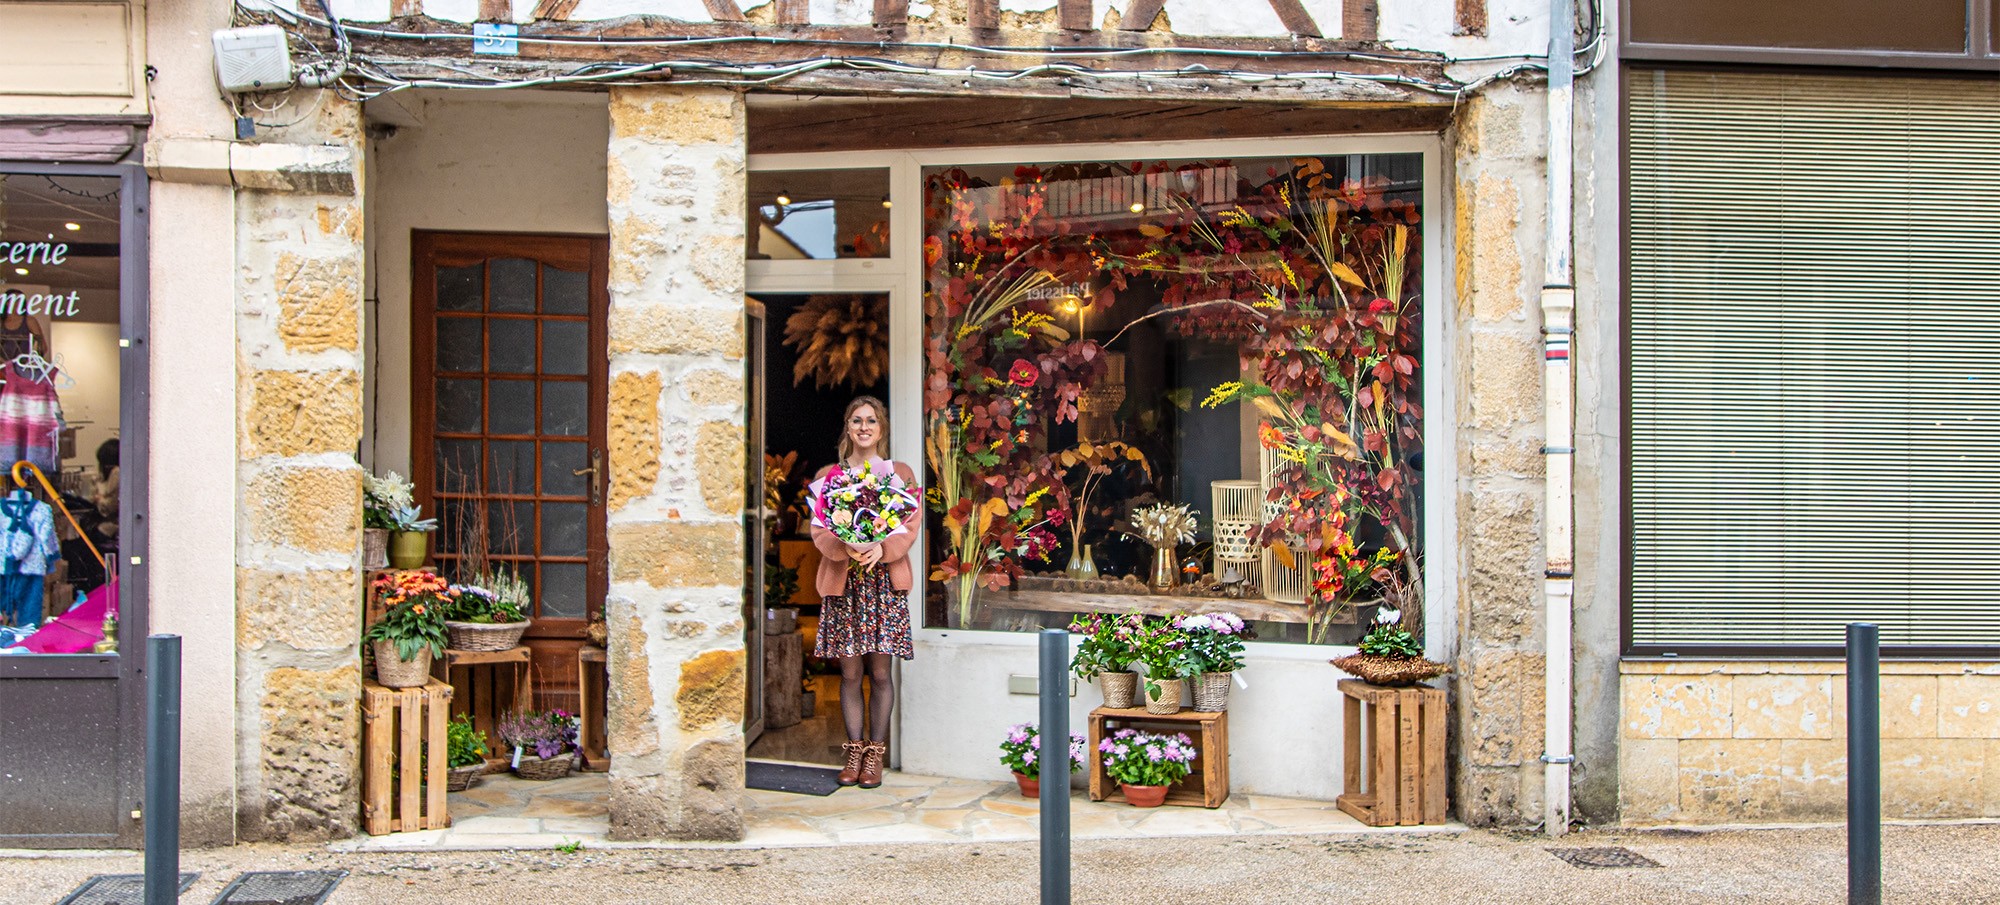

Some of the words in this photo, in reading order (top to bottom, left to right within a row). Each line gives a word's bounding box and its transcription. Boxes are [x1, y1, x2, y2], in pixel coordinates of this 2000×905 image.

[483, 30, 506, 47] 39
[0, 233, 68, 265] cerie
[0, 290, 80, 317] ment
